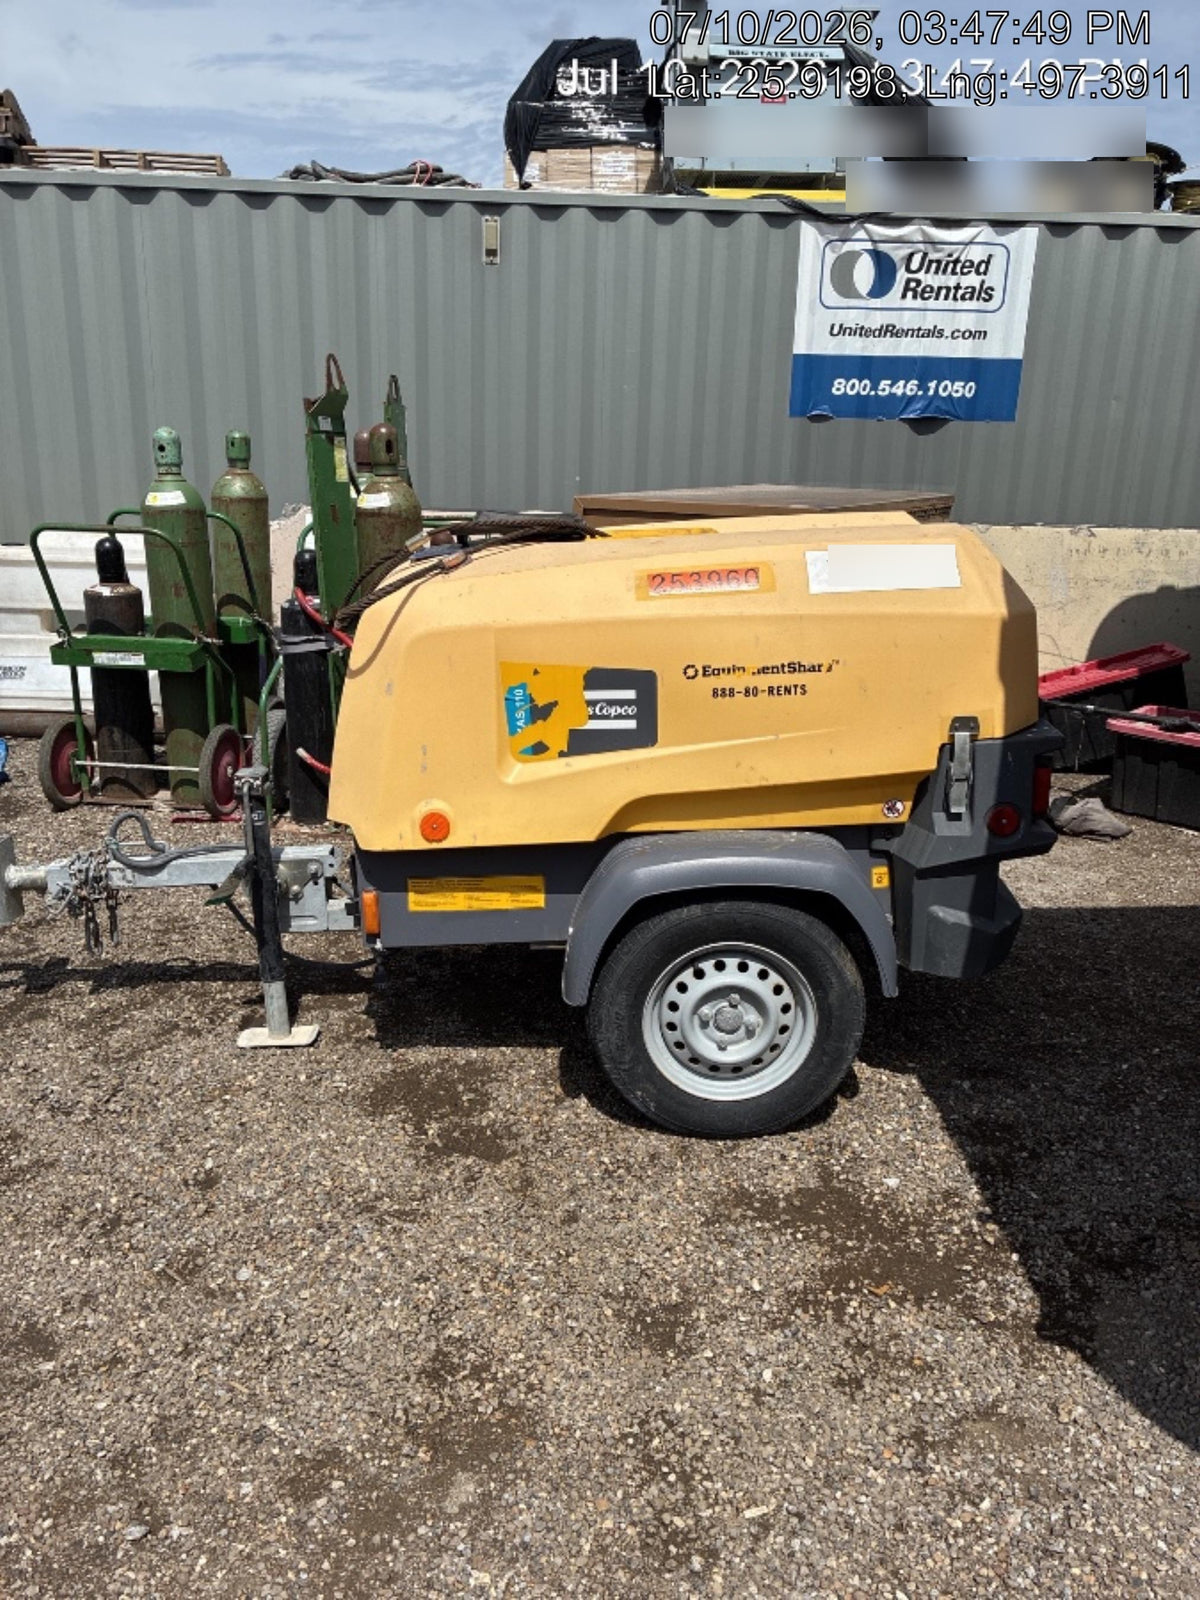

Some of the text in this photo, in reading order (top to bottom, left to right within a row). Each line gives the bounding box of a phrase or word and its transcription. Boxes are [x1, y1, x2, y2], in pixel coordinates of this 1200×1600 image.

[904, 251, 993, 276] United
[901, 277, 995, 303] Rentals
[829, 323, 988, 340] UnitedRentals.com
[831, 377, 977, 398] 800.546.1050
[712, 684, 808, 699] 888-80-RENTS
[595, 702, 637, 718] Copco
